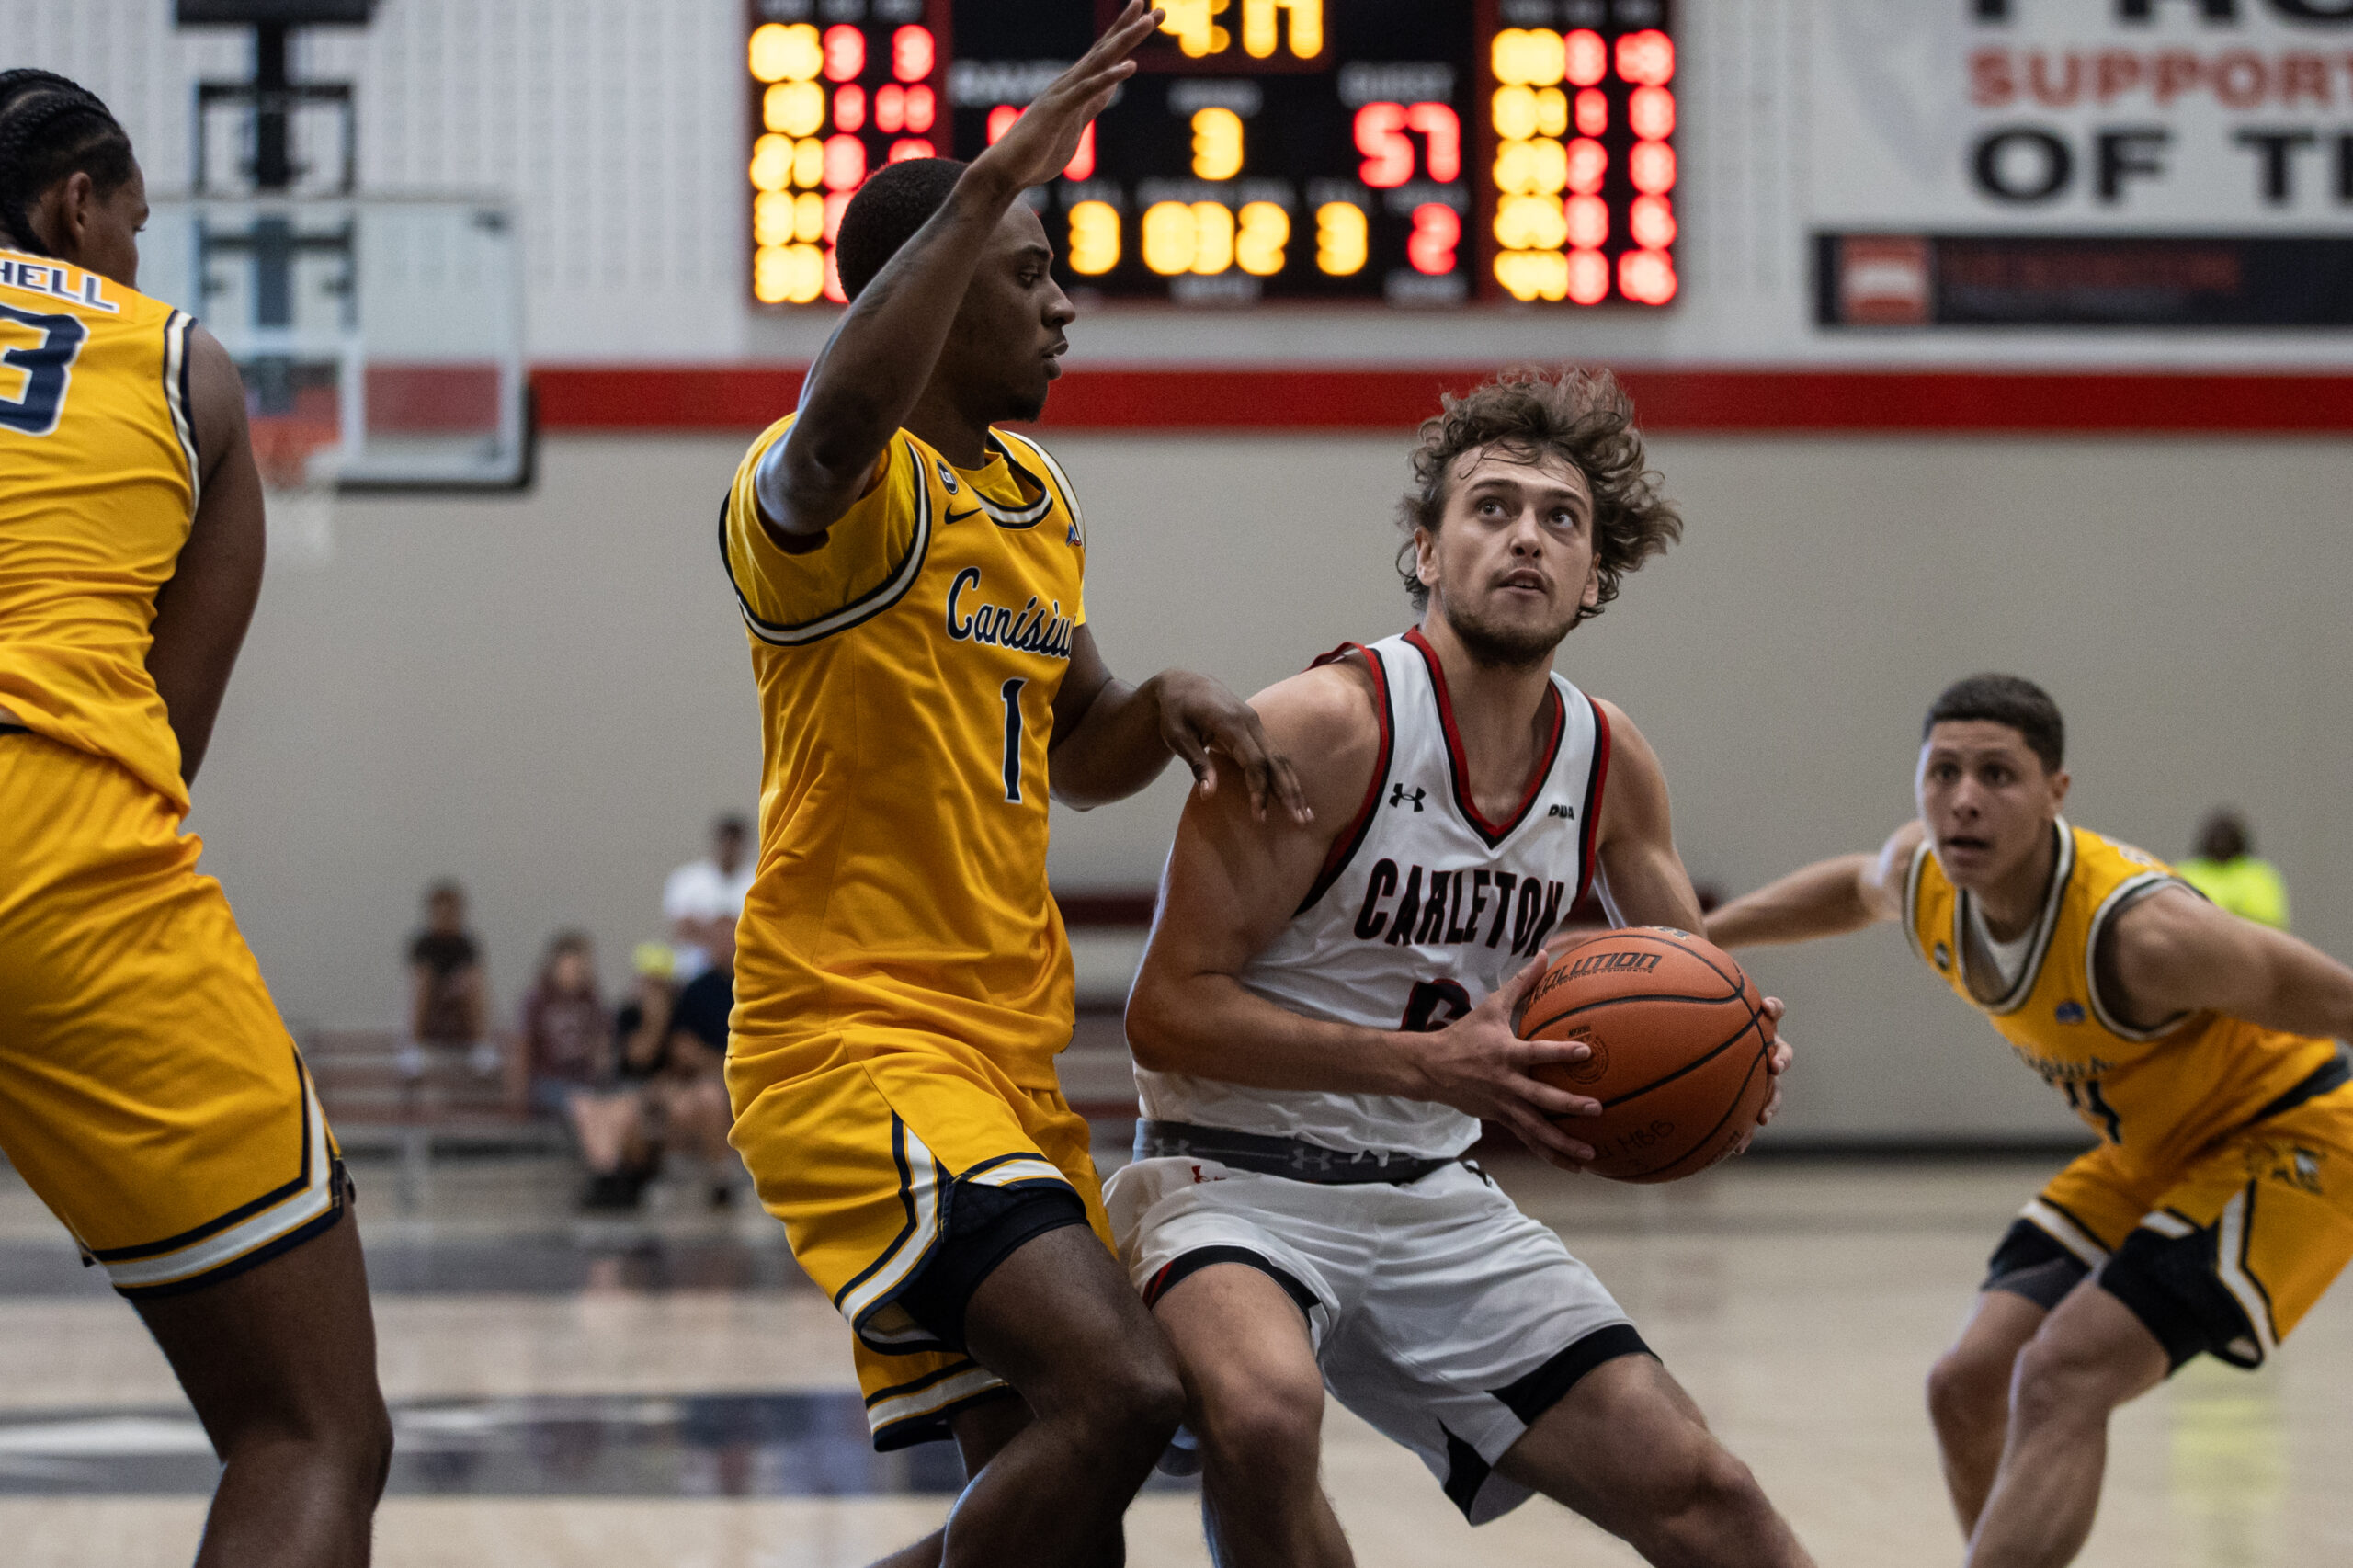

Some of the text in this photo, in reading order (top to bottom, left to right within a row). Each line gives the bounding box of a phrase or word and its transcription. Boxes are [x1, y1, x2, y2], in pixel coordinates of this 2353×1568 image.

[1972, 127, 2169, 210] OF
[947, 566, 1076, 661] Canisiu
[1000, 676, 1029, 804] 1
[1354, 858, 1564, 959] CARLETON
[1531, 952, 1663, 1004] VOLUTION
